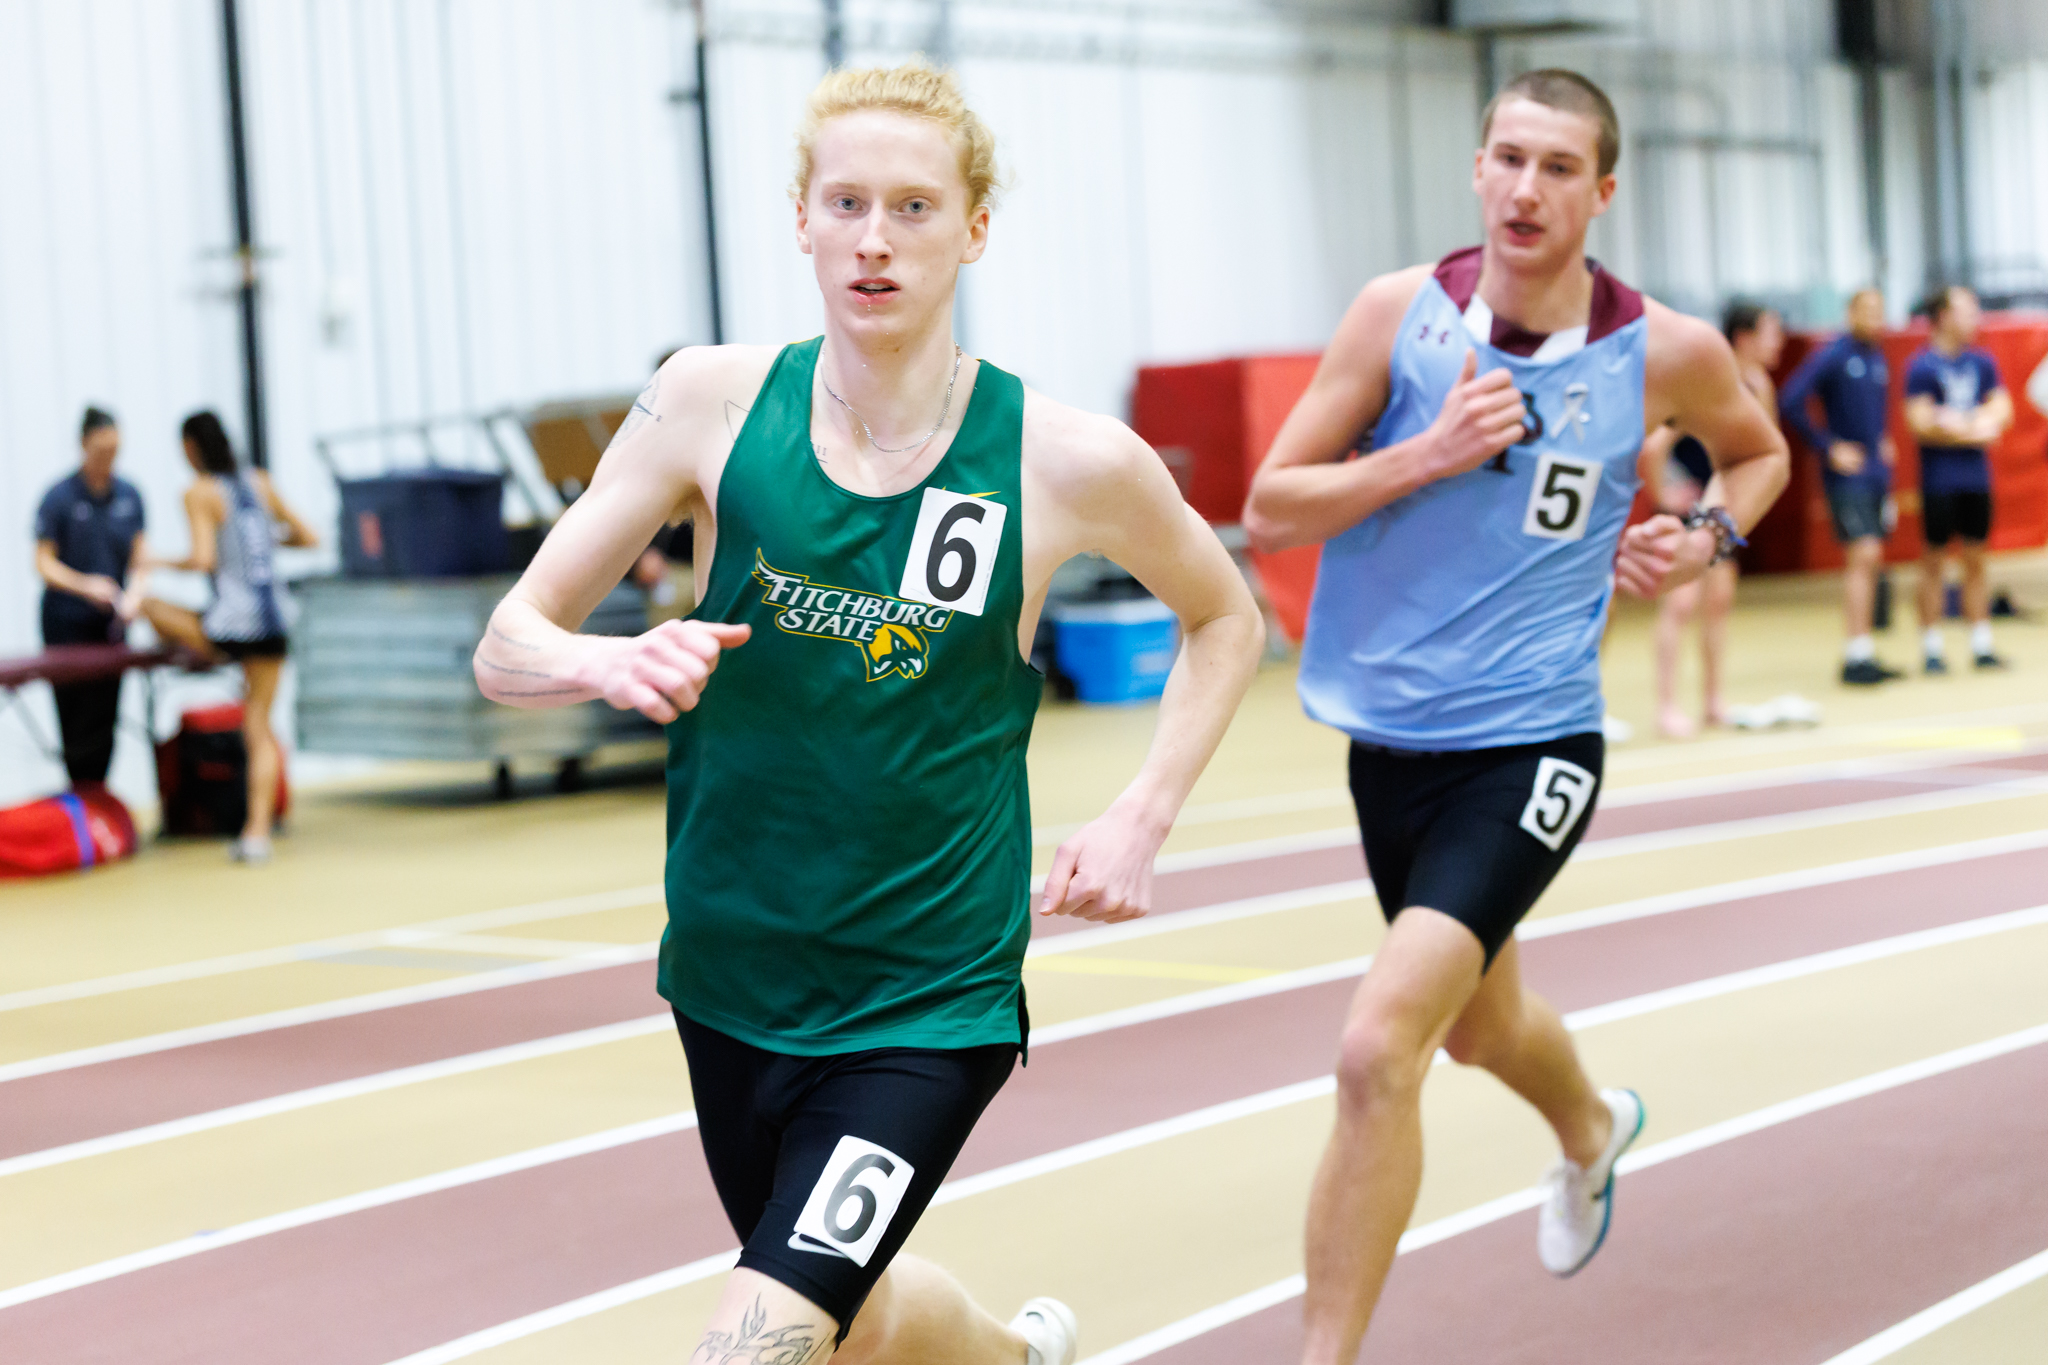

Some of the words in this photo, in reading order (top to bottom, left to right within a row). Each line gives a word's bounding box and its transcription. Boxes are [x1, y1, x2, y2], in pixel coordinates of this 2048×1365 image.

[1536, 463, 1586, 531] 5
[926, 501, 986, 602] 6
[758, 561, 949, 628] FITCHBURG
[778, 608, 882, 641] STATE
[1536, 769, 1582, 834] 5
[823, 1153, 896, 1243] 6
